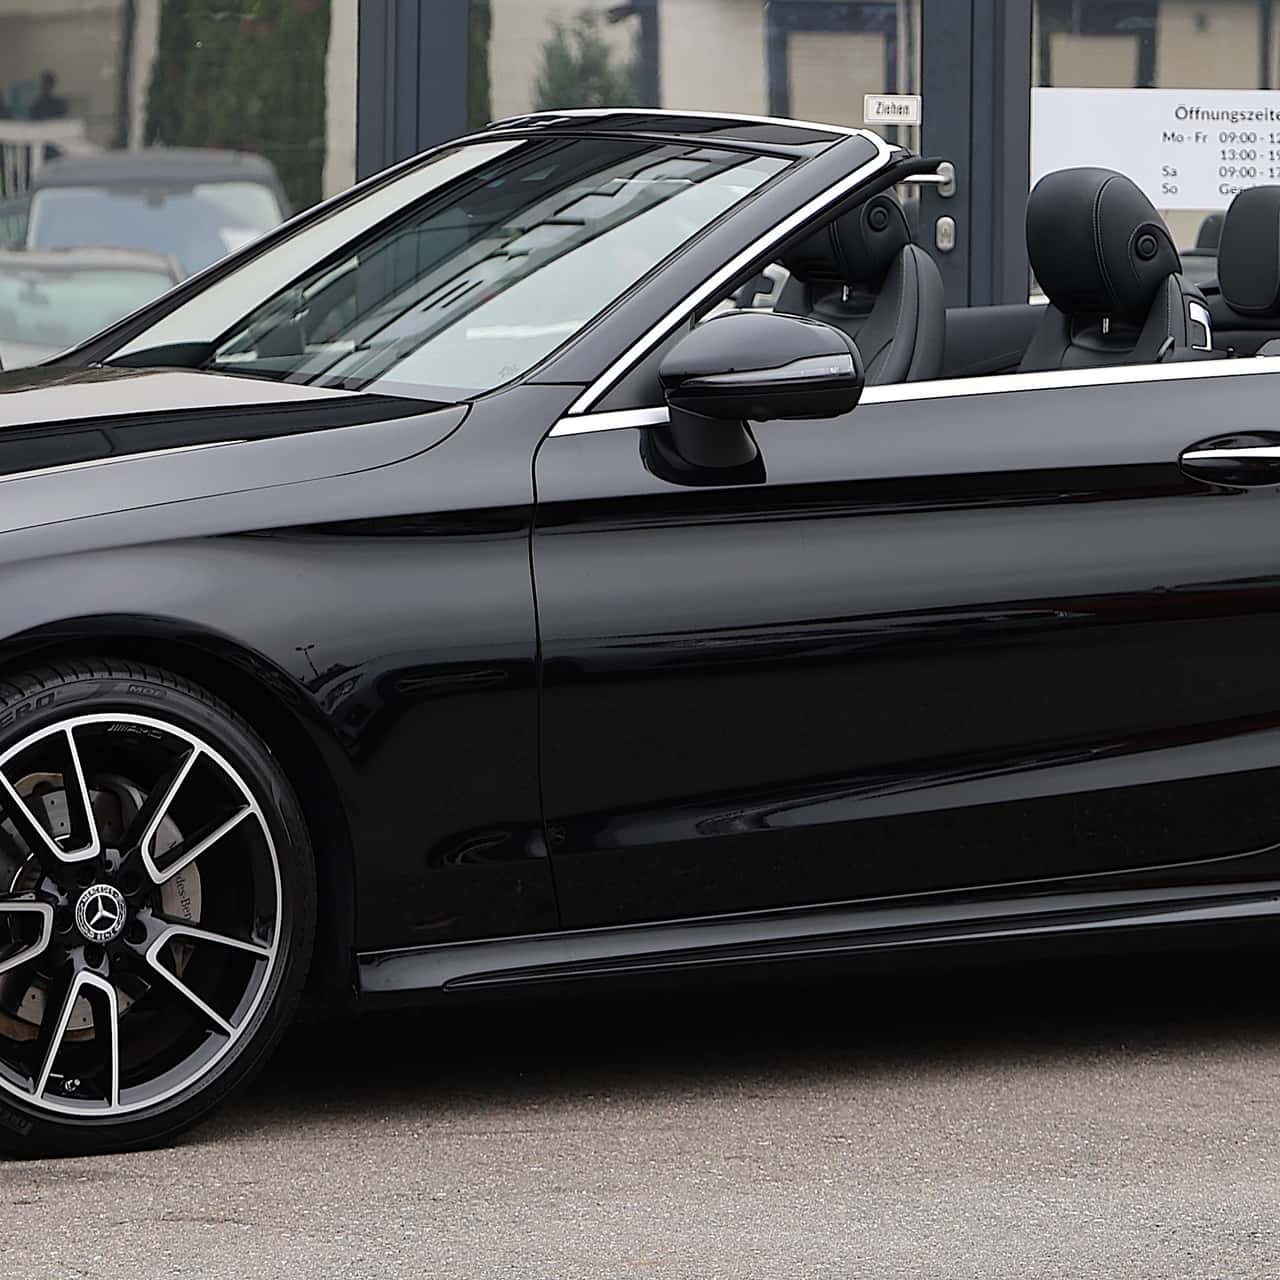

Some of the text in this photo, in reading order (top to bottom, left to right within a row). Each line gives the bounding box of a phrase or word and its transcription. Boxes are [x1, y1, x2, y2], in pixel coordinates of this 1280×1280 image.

[875, 102, 910, 115] Ziehen
[1162, 131, 1184, 143] Mo
[1195, 131, 1209, 143] Fr
[1219, 131, 1257, 143] 09:00
[1220, 149, 1257, 161] 13:00
[1162, 165, 1177, 177] Sa
[1219, 166, 1257, 178] 09:00
[1162, 183, 1178, 195] So
